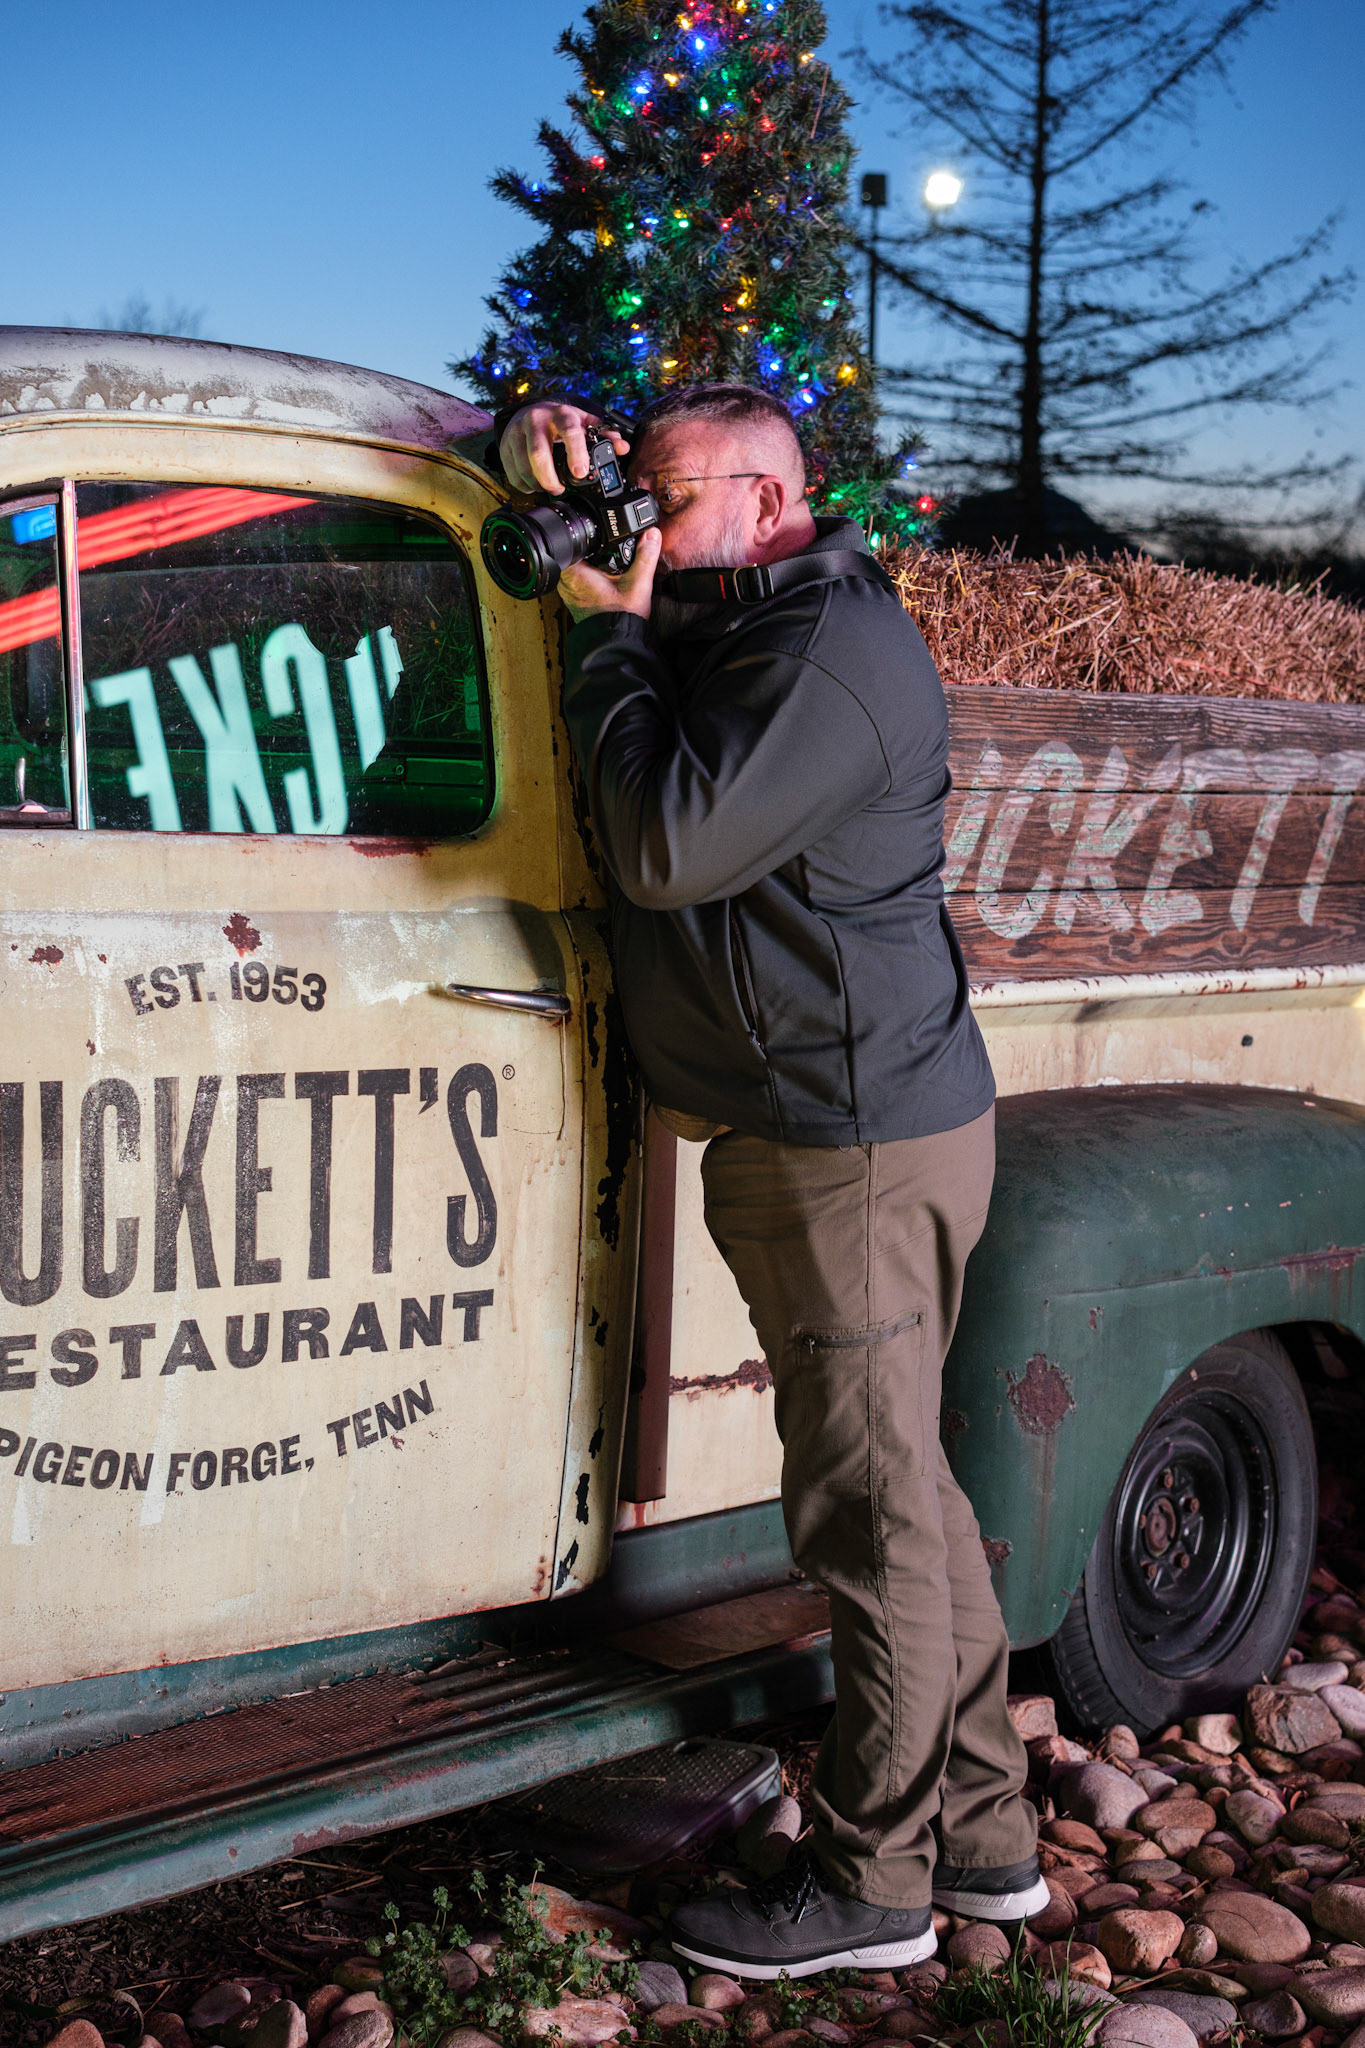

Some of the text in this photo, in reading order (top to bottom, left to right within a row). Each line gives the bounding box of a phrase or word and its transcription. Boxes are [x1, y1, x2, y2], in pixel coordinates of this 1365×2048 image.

[607, 510, 620, 537] Nikon
[124, 960, 327, 1015] EST. 1953
[0, 1289, 494, 1391] ESTAURANT
[0, 1379, 436, 1492] PIGEON FORGE, TENN
